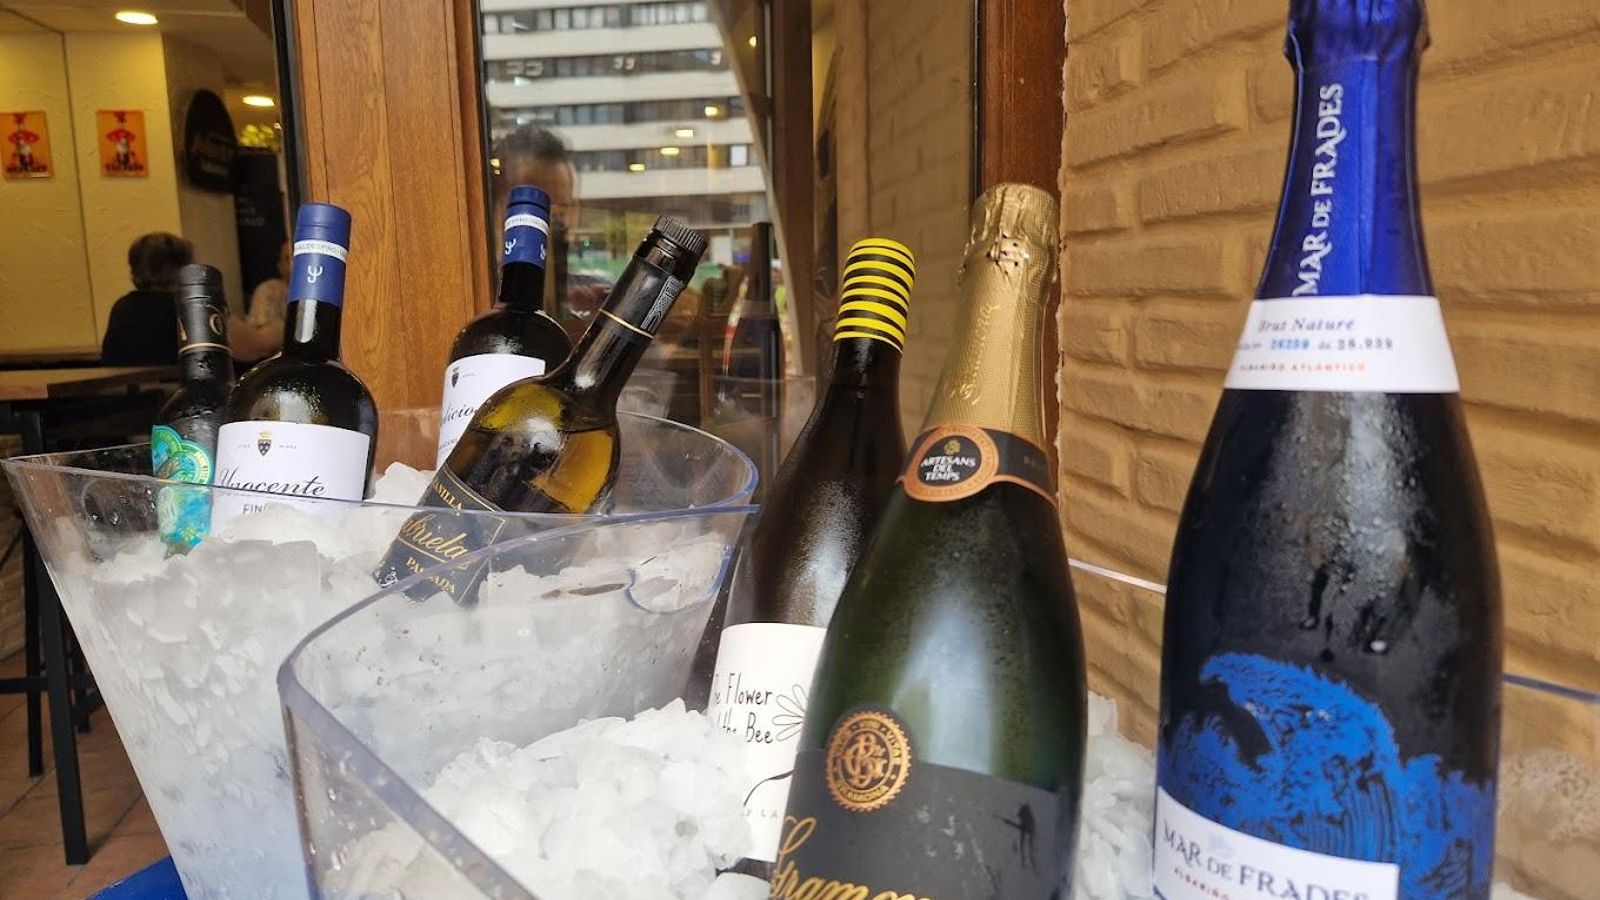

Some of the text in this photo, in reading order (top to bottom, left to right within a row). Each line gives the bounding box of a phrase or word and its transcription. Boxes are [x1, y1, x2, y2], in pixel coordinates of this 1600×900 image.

[1292, 83, 1347, 297] MAR DE FRADES
[1292, 318, 1355, 333] Nature
[920, 455, 976, 468] ARTESANS
[932, 463, 953, 473] DEL
[925, 471, 961, 482] TEMPS
[725, 672, 773, 706] Flower
[746, 711, 774, 744] Bee
[1163, 820, 1201, 868] MAR
[1207, 857, 1233, 881] DE
